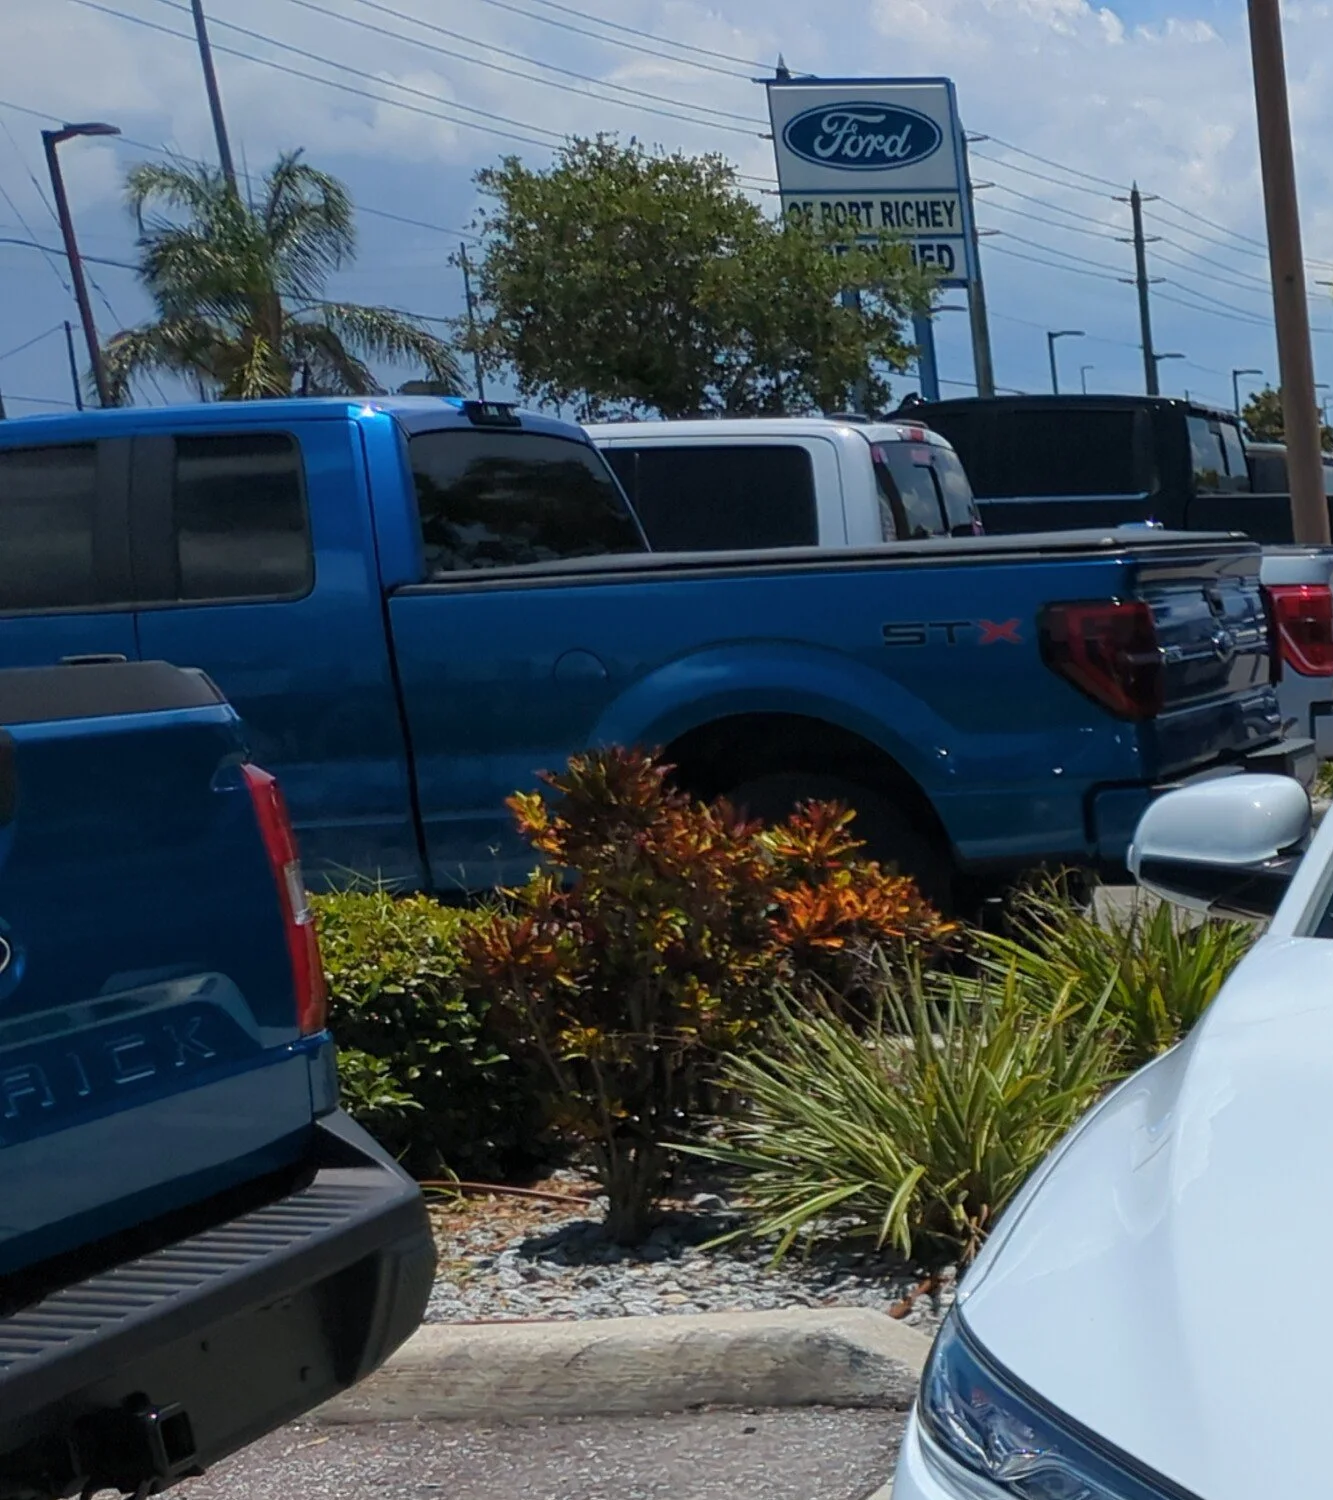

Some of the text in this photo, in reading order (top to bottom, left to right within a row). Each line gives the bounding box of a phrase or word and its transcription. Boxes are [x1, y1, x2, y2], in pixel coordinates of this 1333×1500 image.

[813, 112, 912, 158] Ford
[820, 201, 874, 230] PORT
[881, 200, 956, 229] RICHEY
[881, 618, 1023, 647] STX
